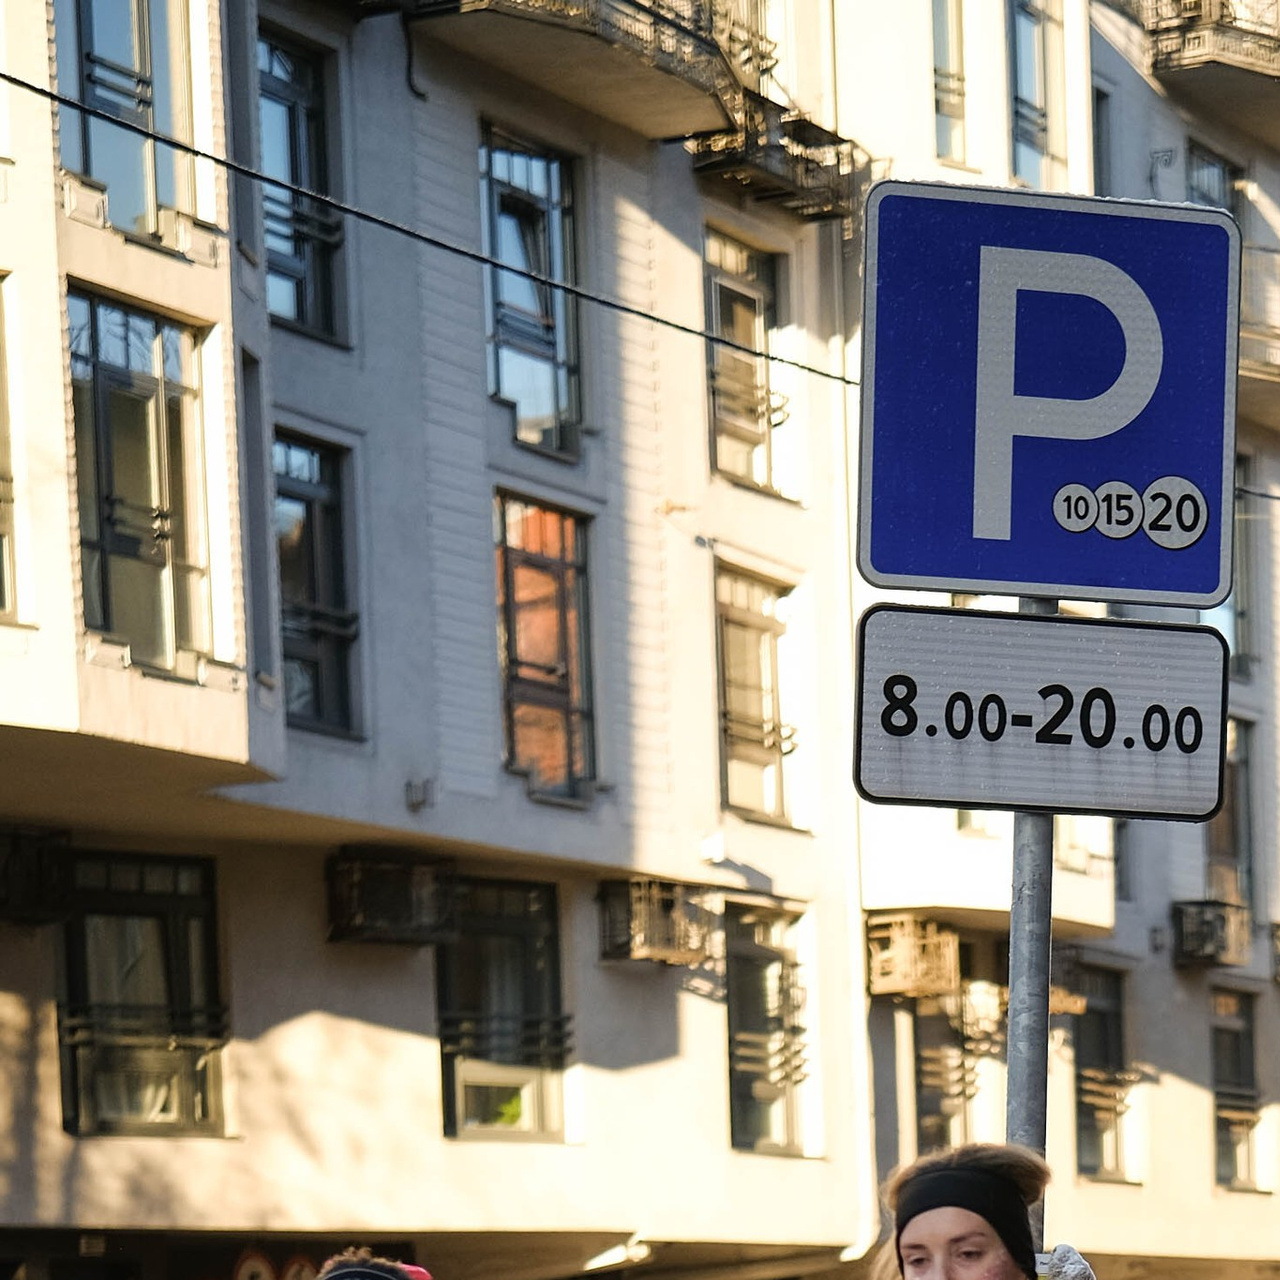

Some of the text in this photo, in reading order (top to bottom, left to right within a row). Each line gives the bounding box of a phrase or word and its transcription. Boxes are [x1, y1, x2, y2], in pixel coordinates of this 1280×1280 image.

[972, 244, 1164, 541] P
[1062, 491, 1201, 534] 10 15 20
[880, 673, 1204, 755] 8.00-20.00
